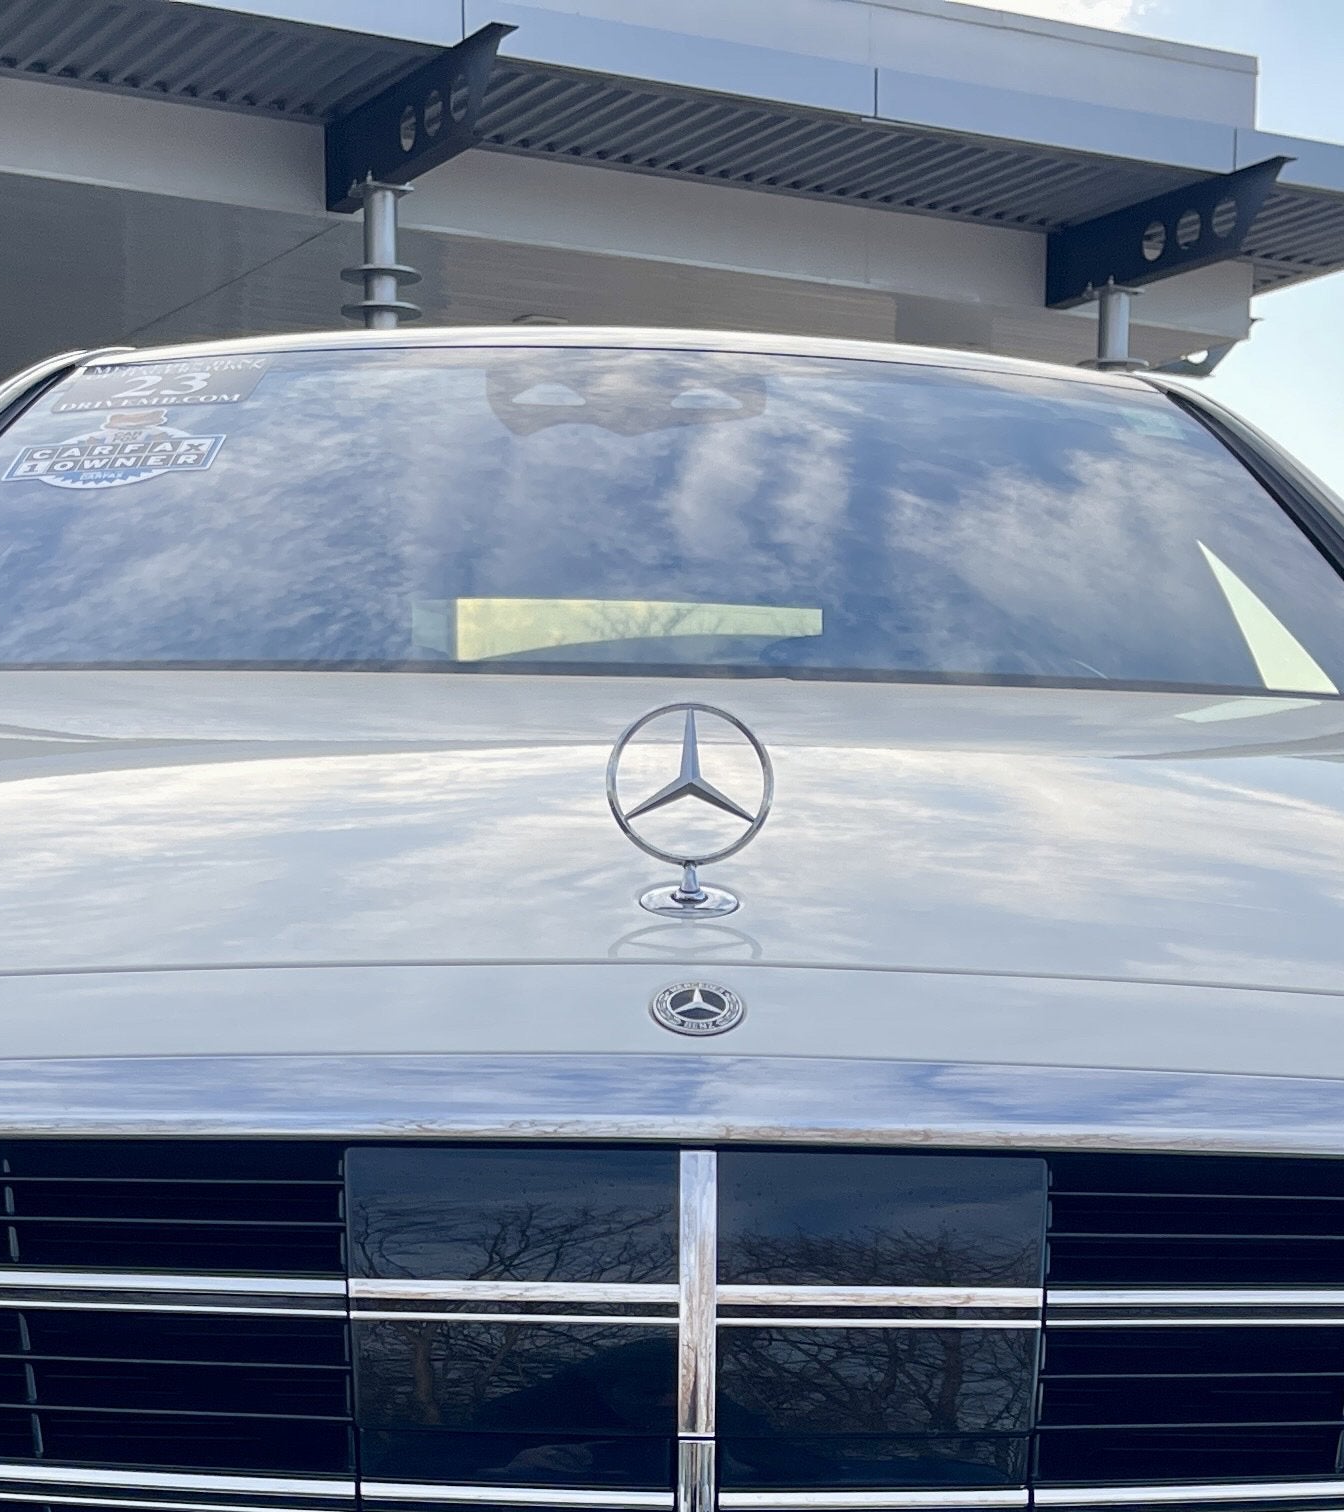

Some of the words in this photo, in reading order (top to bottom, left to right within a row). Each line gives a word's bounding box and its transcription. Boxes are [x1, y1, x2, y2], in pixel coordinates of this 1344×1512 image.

[111, 372, 212, 398] 23
[32, 442, 206, 460] CARFAX
[22, 463, 41, 474] 1
[53, 454, 198, 472] OWNER
